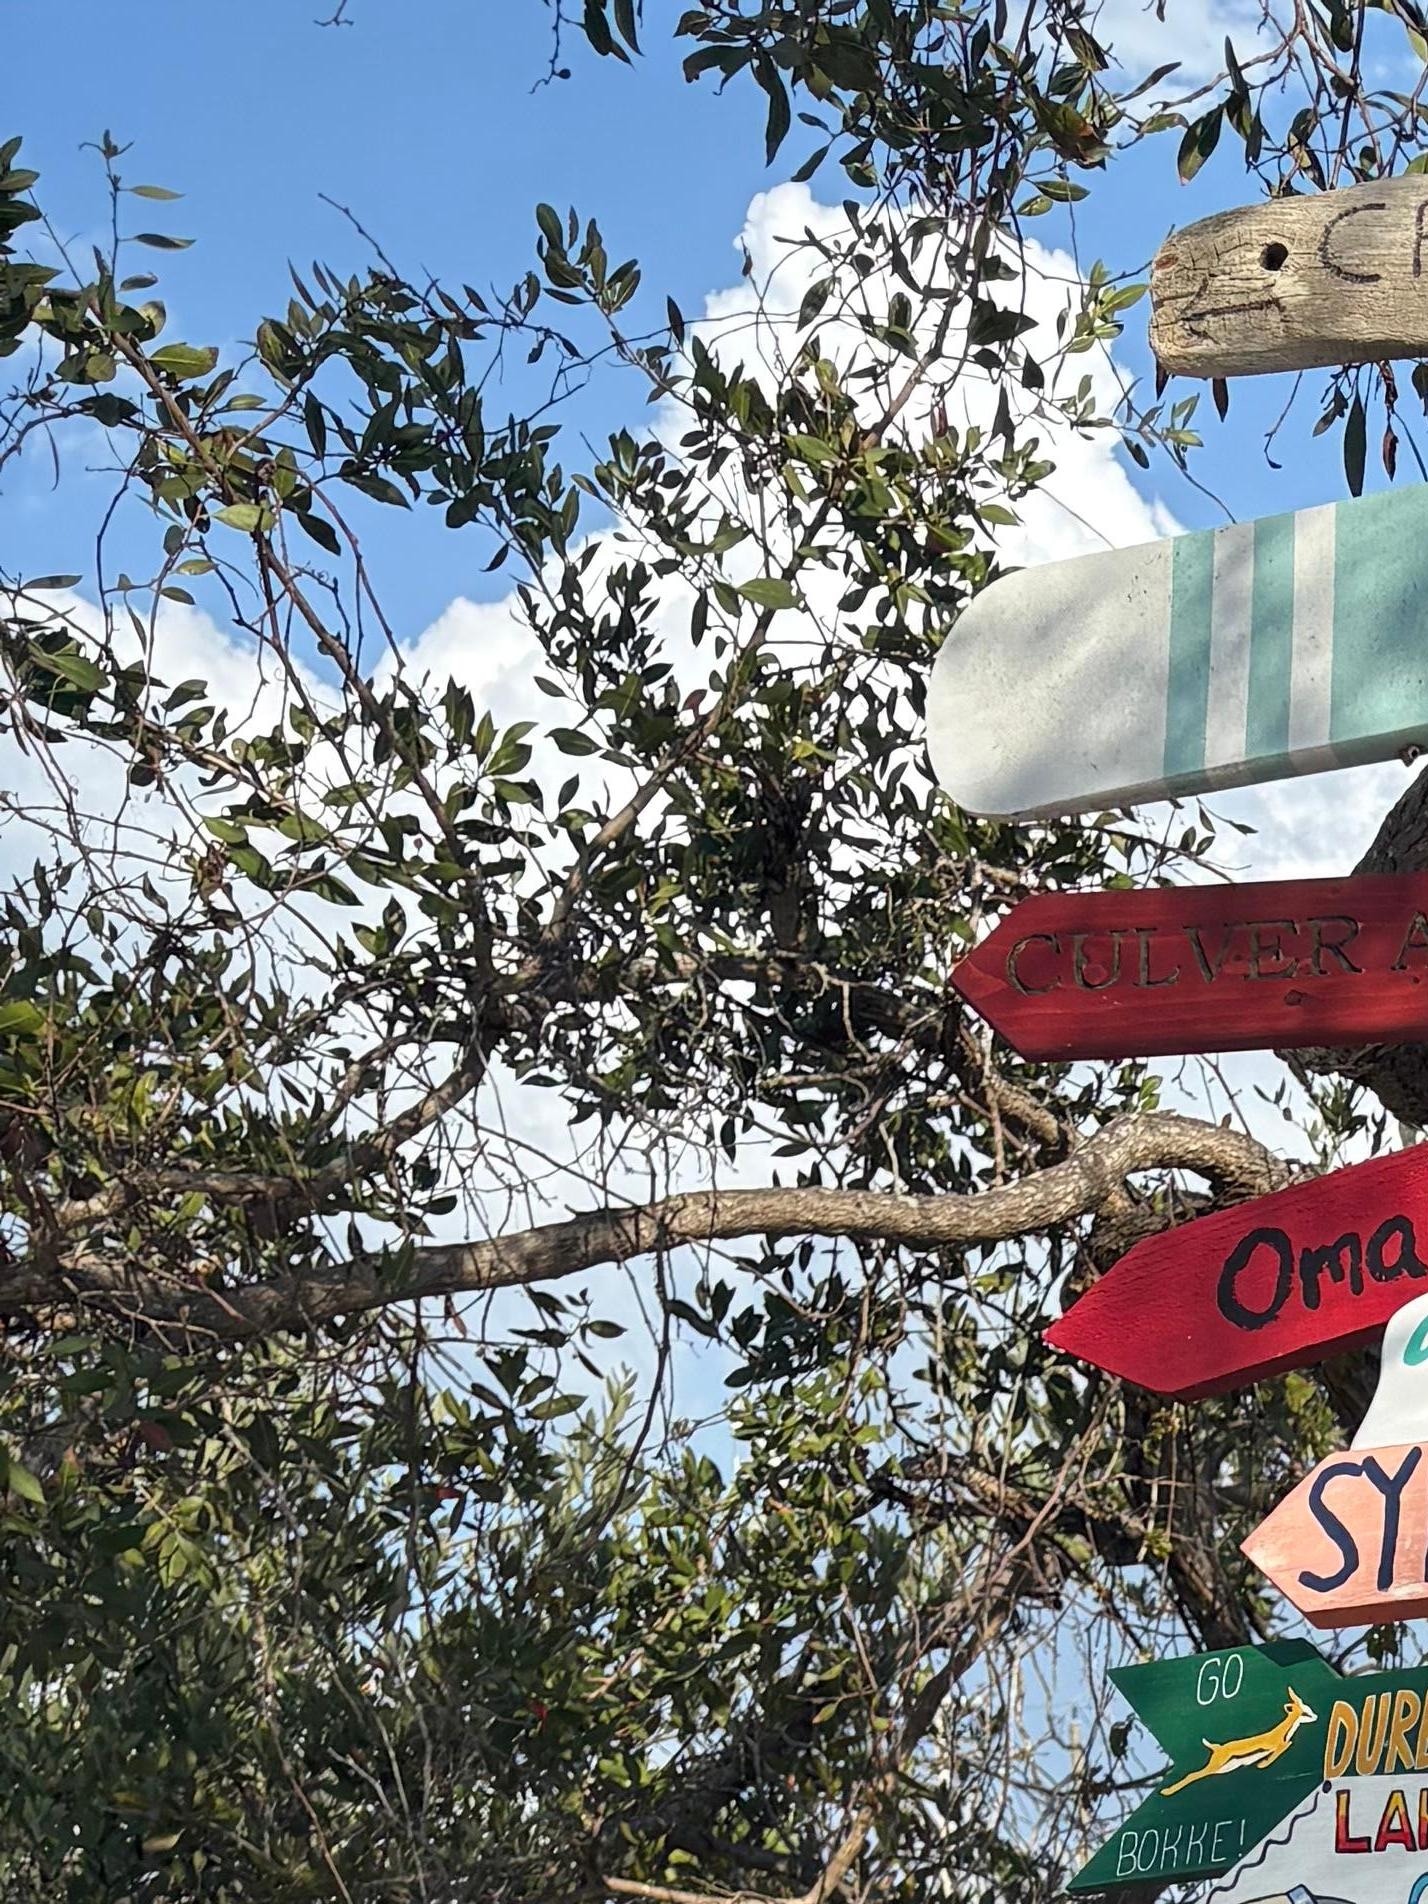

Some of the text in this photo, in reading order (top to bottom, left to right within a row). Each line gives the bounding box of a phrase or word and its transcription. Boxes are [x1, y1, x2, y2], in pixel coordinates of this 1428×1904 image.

[1005, 914, 1365, 996] CULVER
[1195, 1652, 1245, 1706] GO
[1115, 1818, 1247, 1879] BOKKE!
